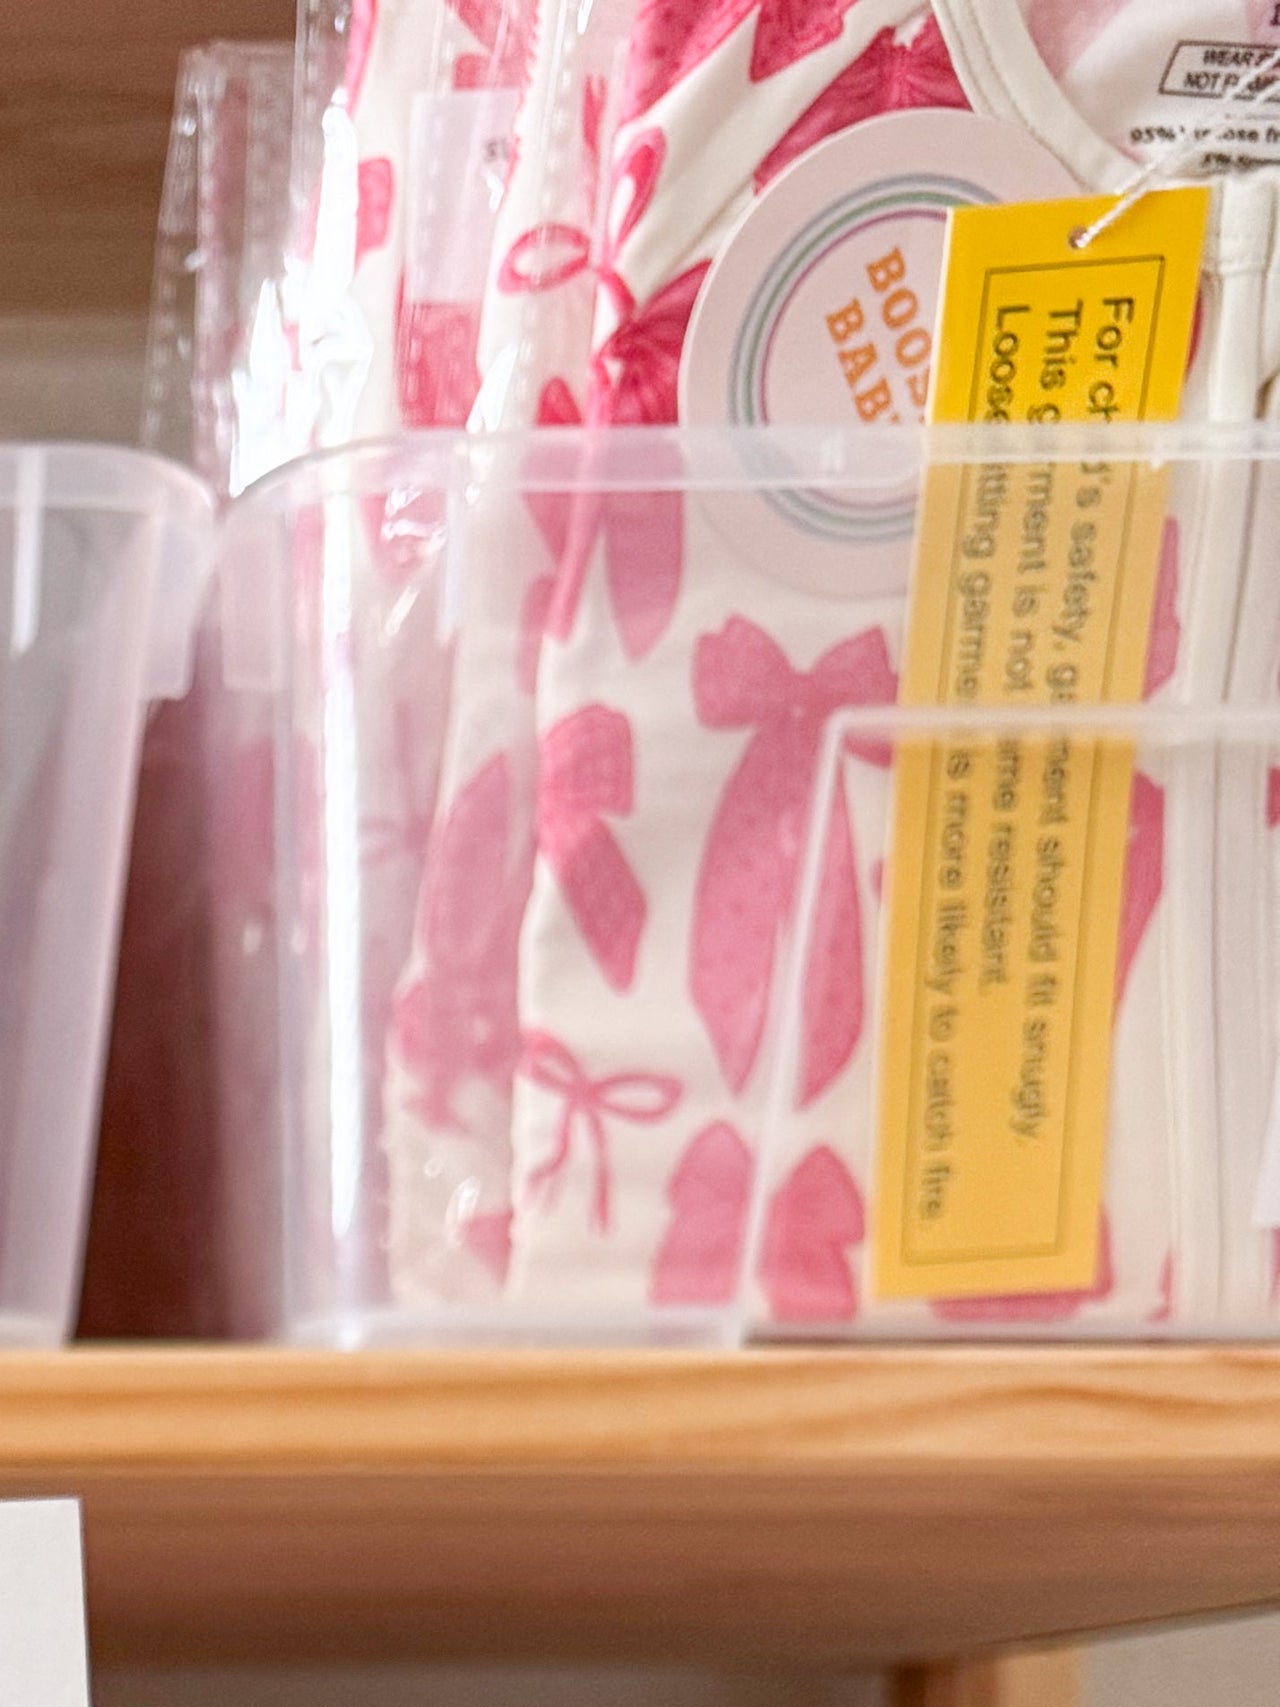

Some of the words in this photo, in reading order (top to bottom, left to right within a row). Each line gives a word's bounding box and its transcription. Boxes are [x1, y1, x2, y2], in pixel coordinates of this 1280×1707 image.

[825, 297, 901, 424] BAB
[1040, 298, 1083, 390] This
[1095, 297, 1135, 370] For
[1012, 585, 1046, 618] is
[1004, 629, 1035, 691] not
[938, 791, 969, 889] more
[1029, 838, 1065, 962] should
[925, 899, 968, 995] likely
[1025, 972, 1058, 1008] fit
[928, 1003, 959, 1042] to
[923, 1050, 955, 1152] catch
